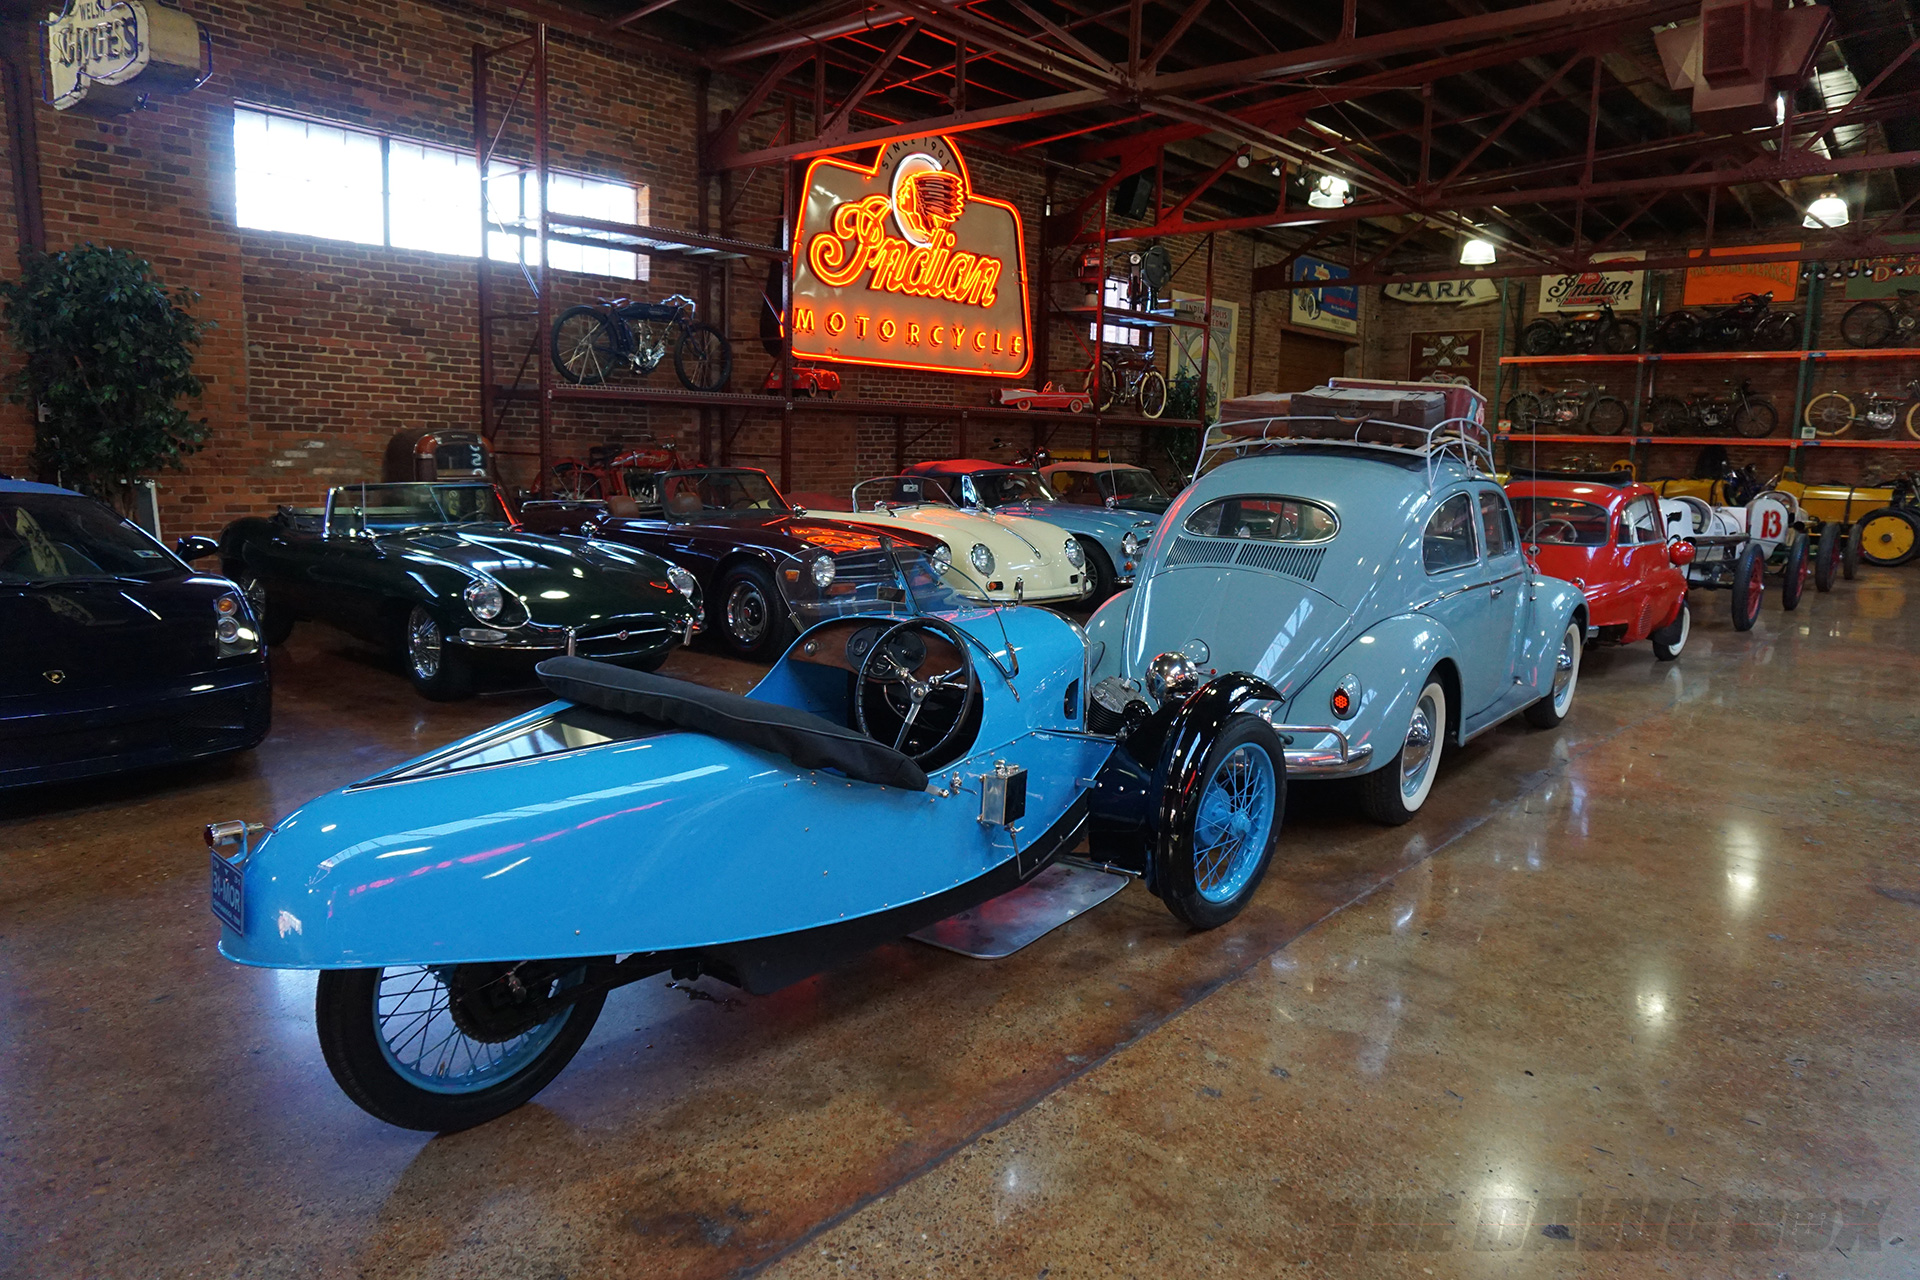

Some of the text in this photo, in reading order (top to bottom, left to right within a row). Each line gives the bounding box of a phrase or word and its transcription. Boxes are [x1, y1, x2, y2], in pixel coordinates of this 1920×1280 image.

[79, 2, 106, 21] WELSH
[924, 137, 951, 167] 1901
[807, 194, 1003, 310] Indian
[1397, 279, 1476, 299] PARK
[1548, 274, 1634, 298] Indian
[794, 306, 1024, 357] MOTORCYCLE
[1761, 510, 1782, 538] 13
[213, 871, 241, 912] 31-MOR
